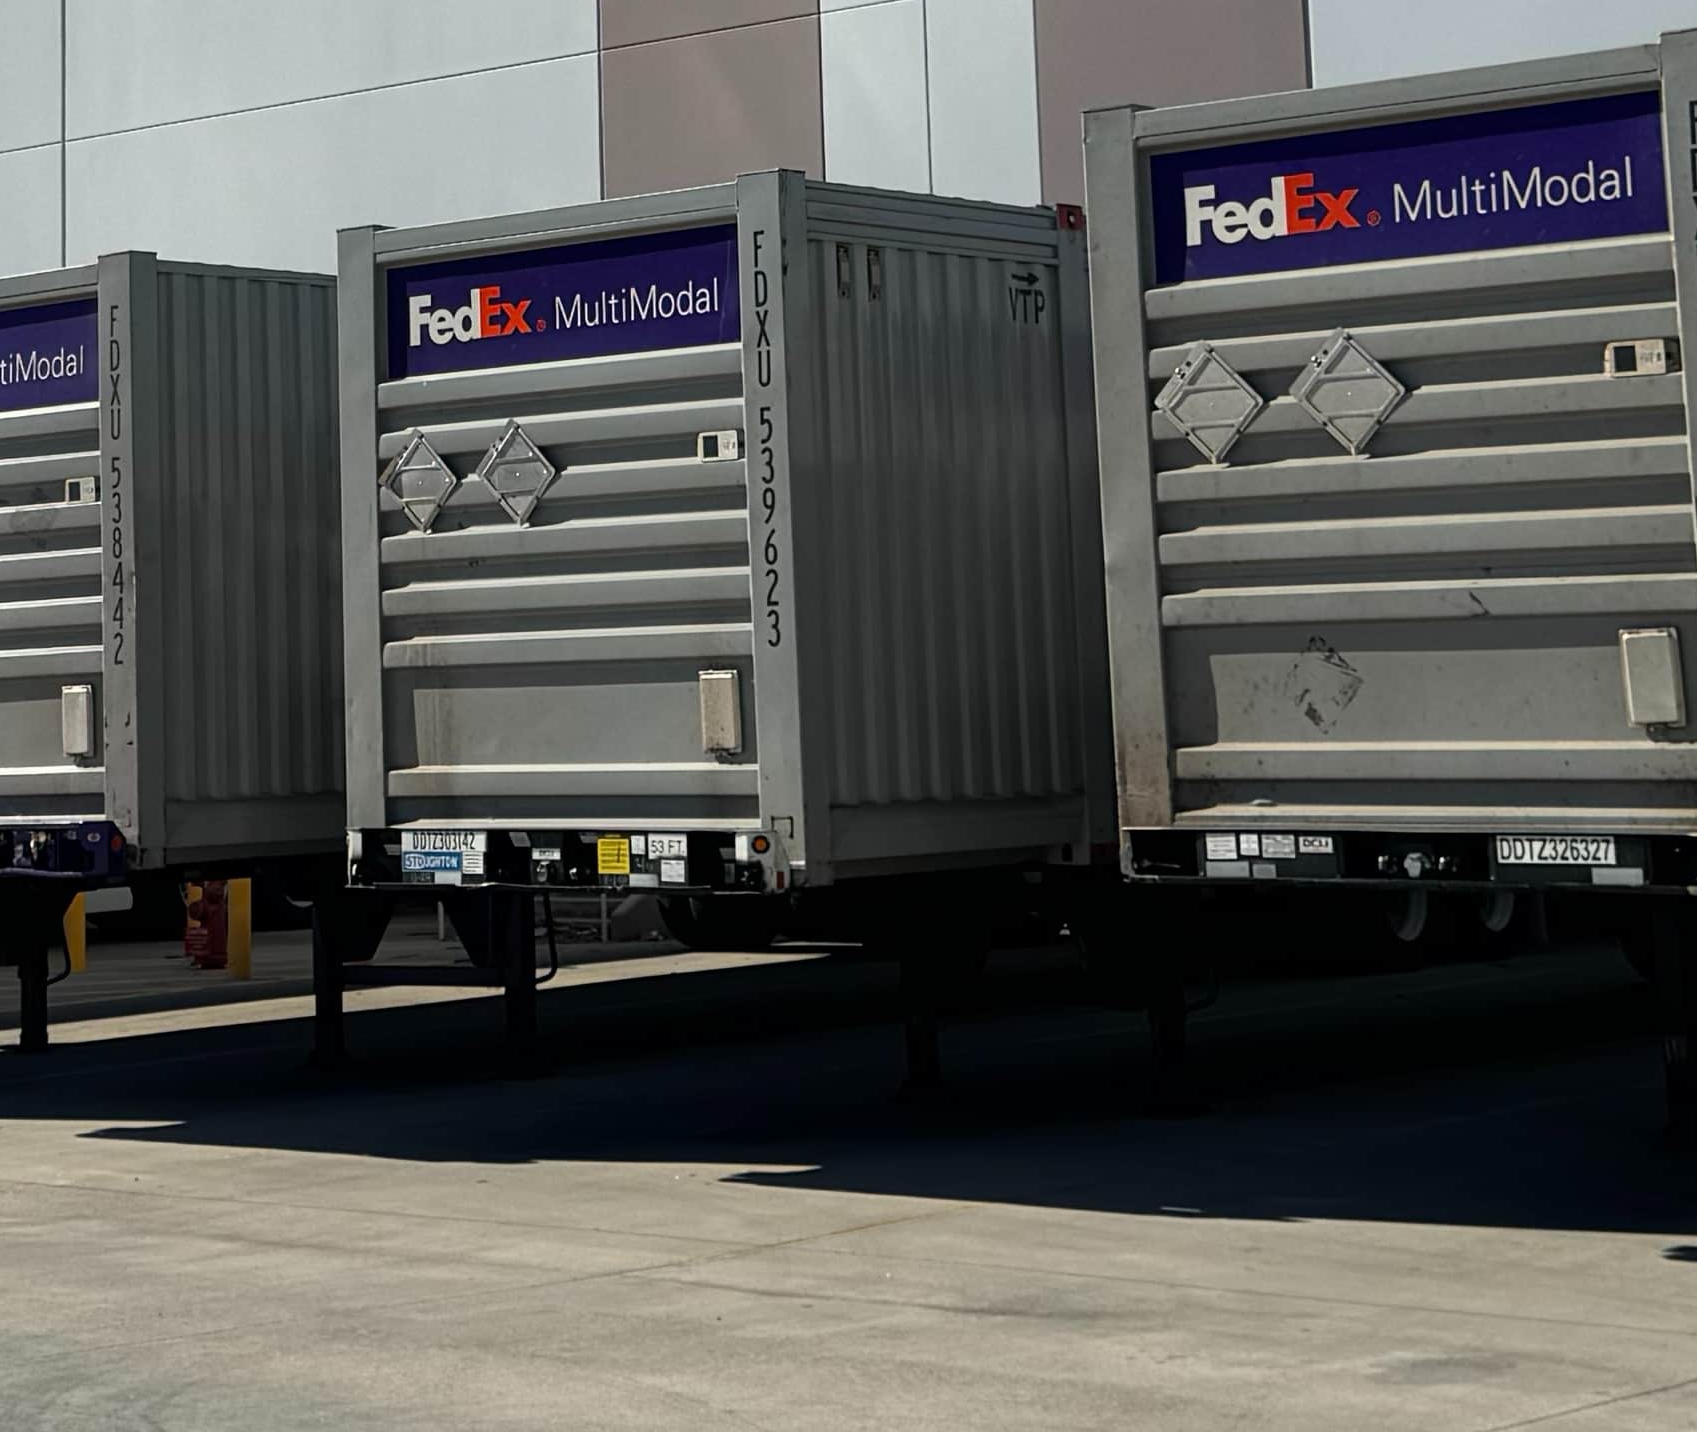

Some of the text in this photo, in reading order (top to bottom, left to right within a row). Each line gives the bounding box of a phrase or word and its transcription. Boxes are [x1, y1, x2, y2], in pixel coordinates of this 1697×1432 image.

[1183, 155, 1634, 248] FedEx MultiModal
[408, 277, 719, 347] FedEx MultiModal
[1008, 287, 1046, 324] VTP
[753, 230, 782, 649] FDXU 539623
[109, 305, 125, 666] FDXU 538442
[1499, 838, 1611, 862] DDTZ326327
